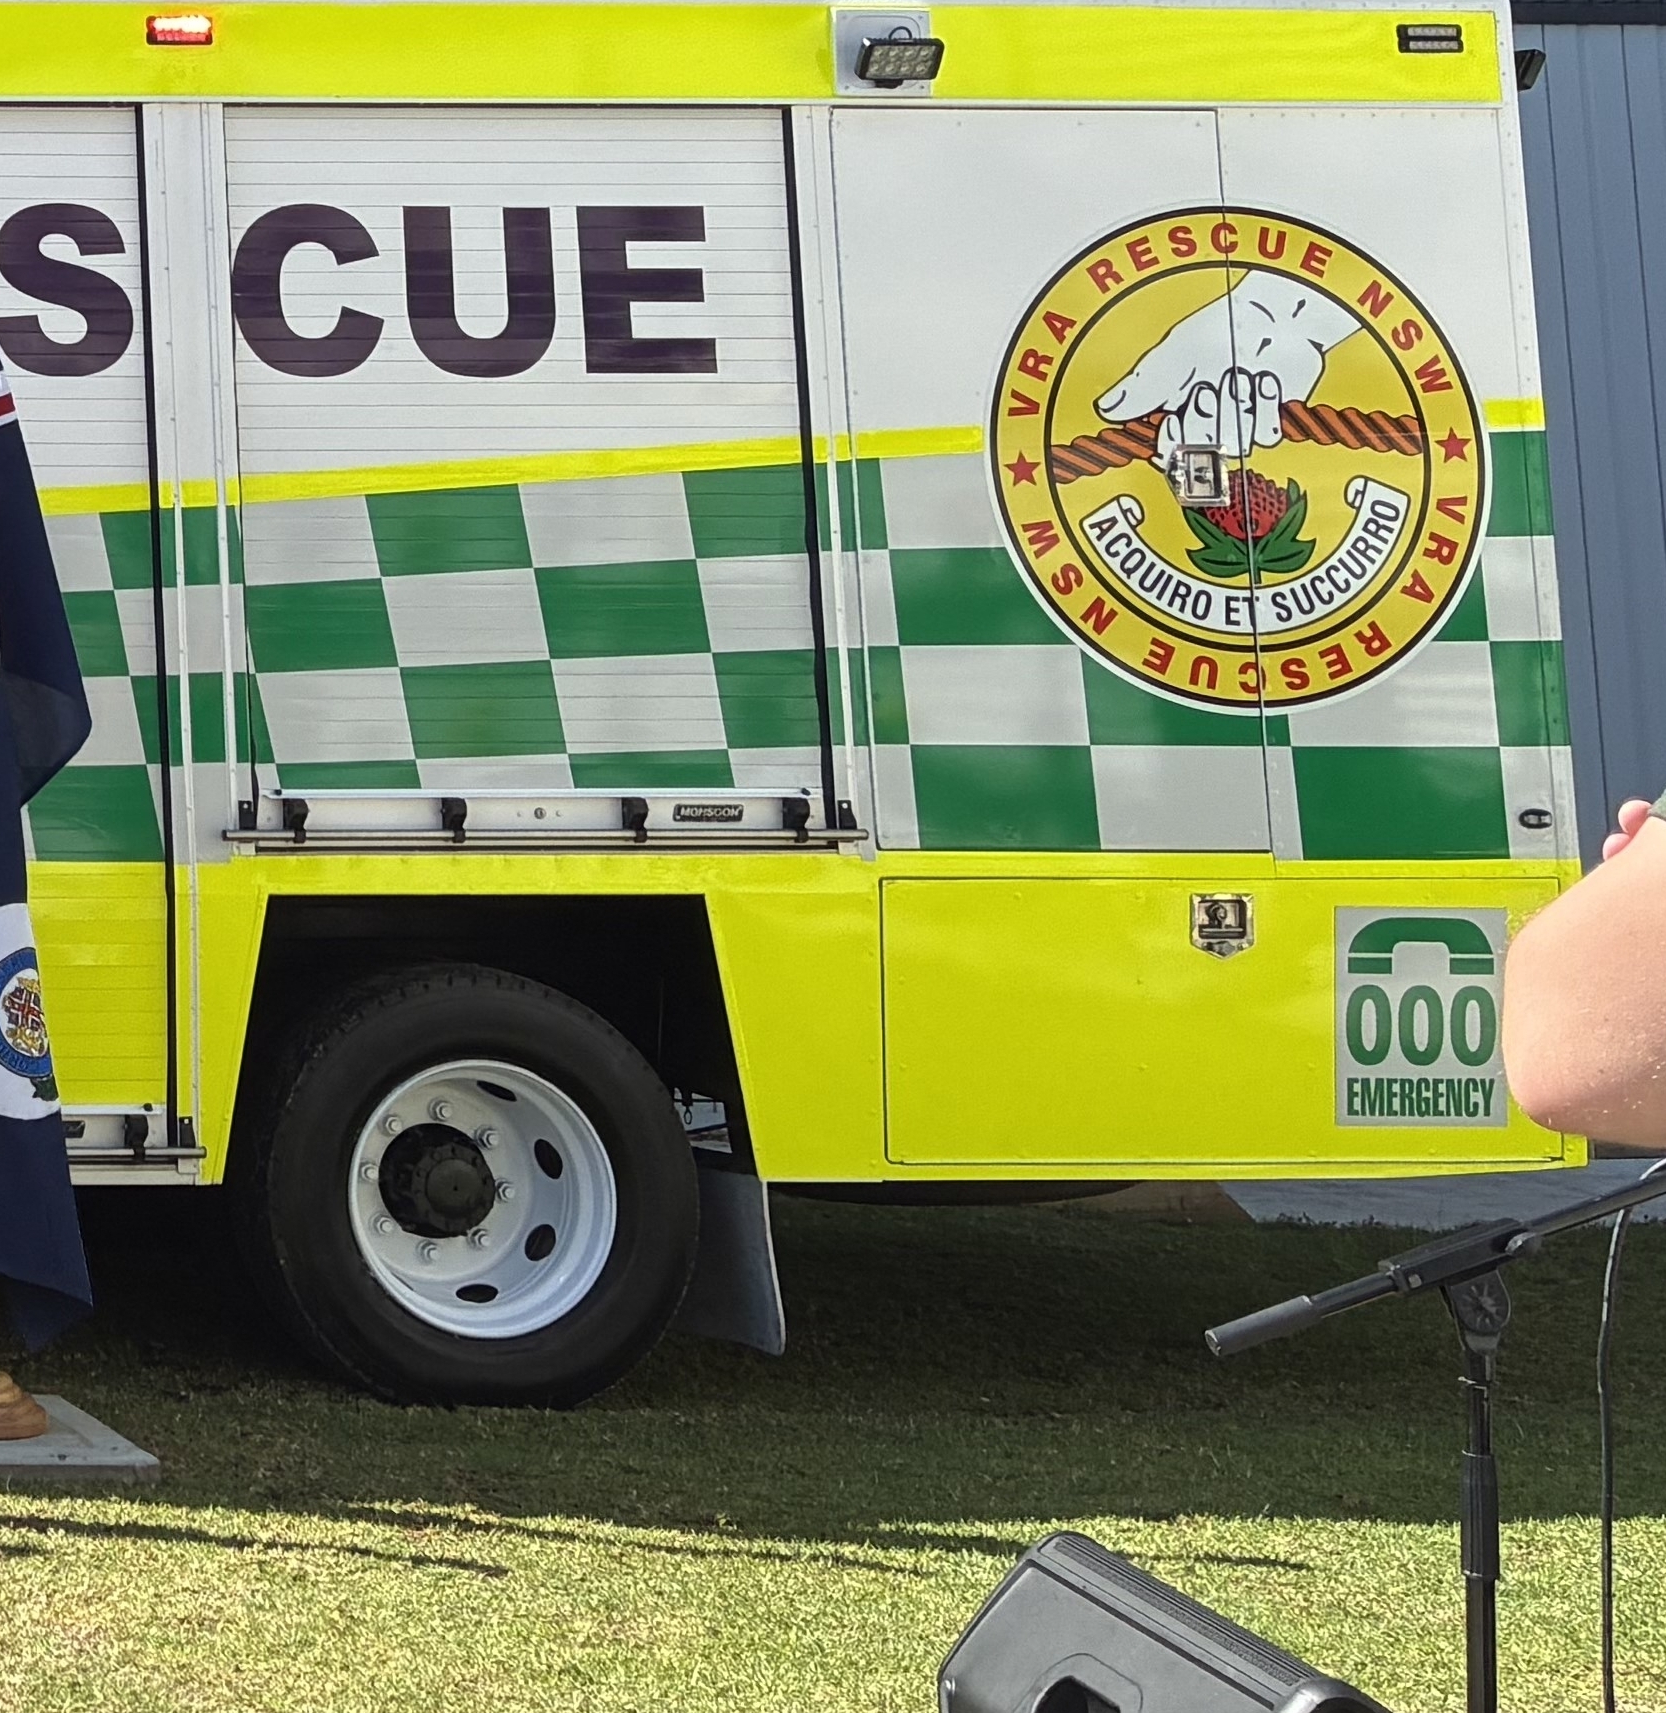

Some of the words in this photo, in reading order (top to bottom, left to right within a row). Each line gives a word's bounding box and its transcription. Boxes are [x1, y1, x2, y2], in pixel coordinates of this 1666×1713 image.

[1008, 310, 1077, 418] VRA
[1086, 222, 1334, 295] RESCUE
[1357, 280, 1454, 395] NSW
[1021, 519, 1119, 636] NSW
[1088, 515, 1213, 622] ACQUIRO
[1224, 595, 1260, 628] ET
[1272, 498, 1401, 623] SUCCURRO
[1400, 495, 1468, 605] VRA
[1142, 619, 1393, 695] RESCUE
[1345, 984, 1497, 1067] 000
[1346, 1077, 1496, 1118] EMERGENCY
